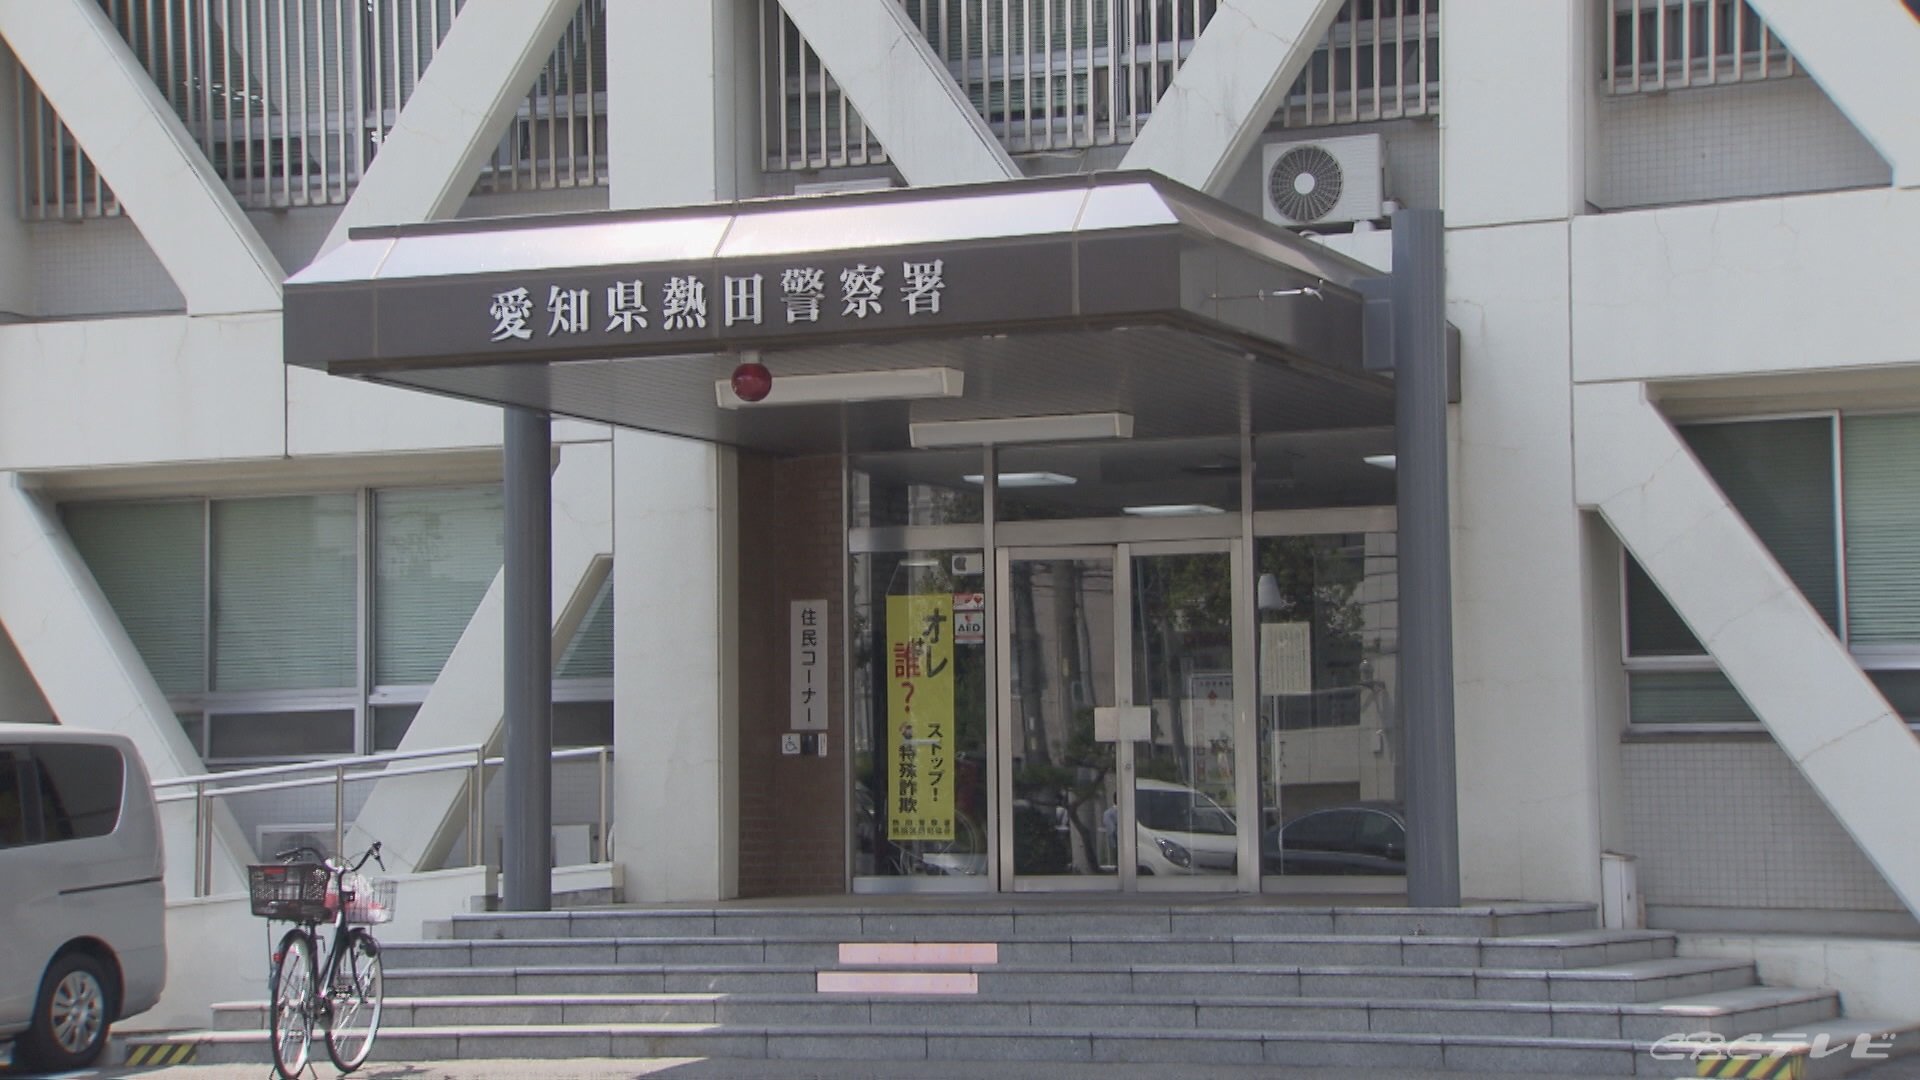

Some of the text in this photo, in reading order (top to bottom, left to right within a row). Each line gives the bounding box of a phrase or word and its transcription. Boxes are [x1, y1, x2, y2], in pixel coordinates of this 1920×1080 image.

[489, 259, 946, 342] 愛知県熱田警察署
[801, 608, 817, 722] 住民コーナー
[958, 623, 981, 632] AED
